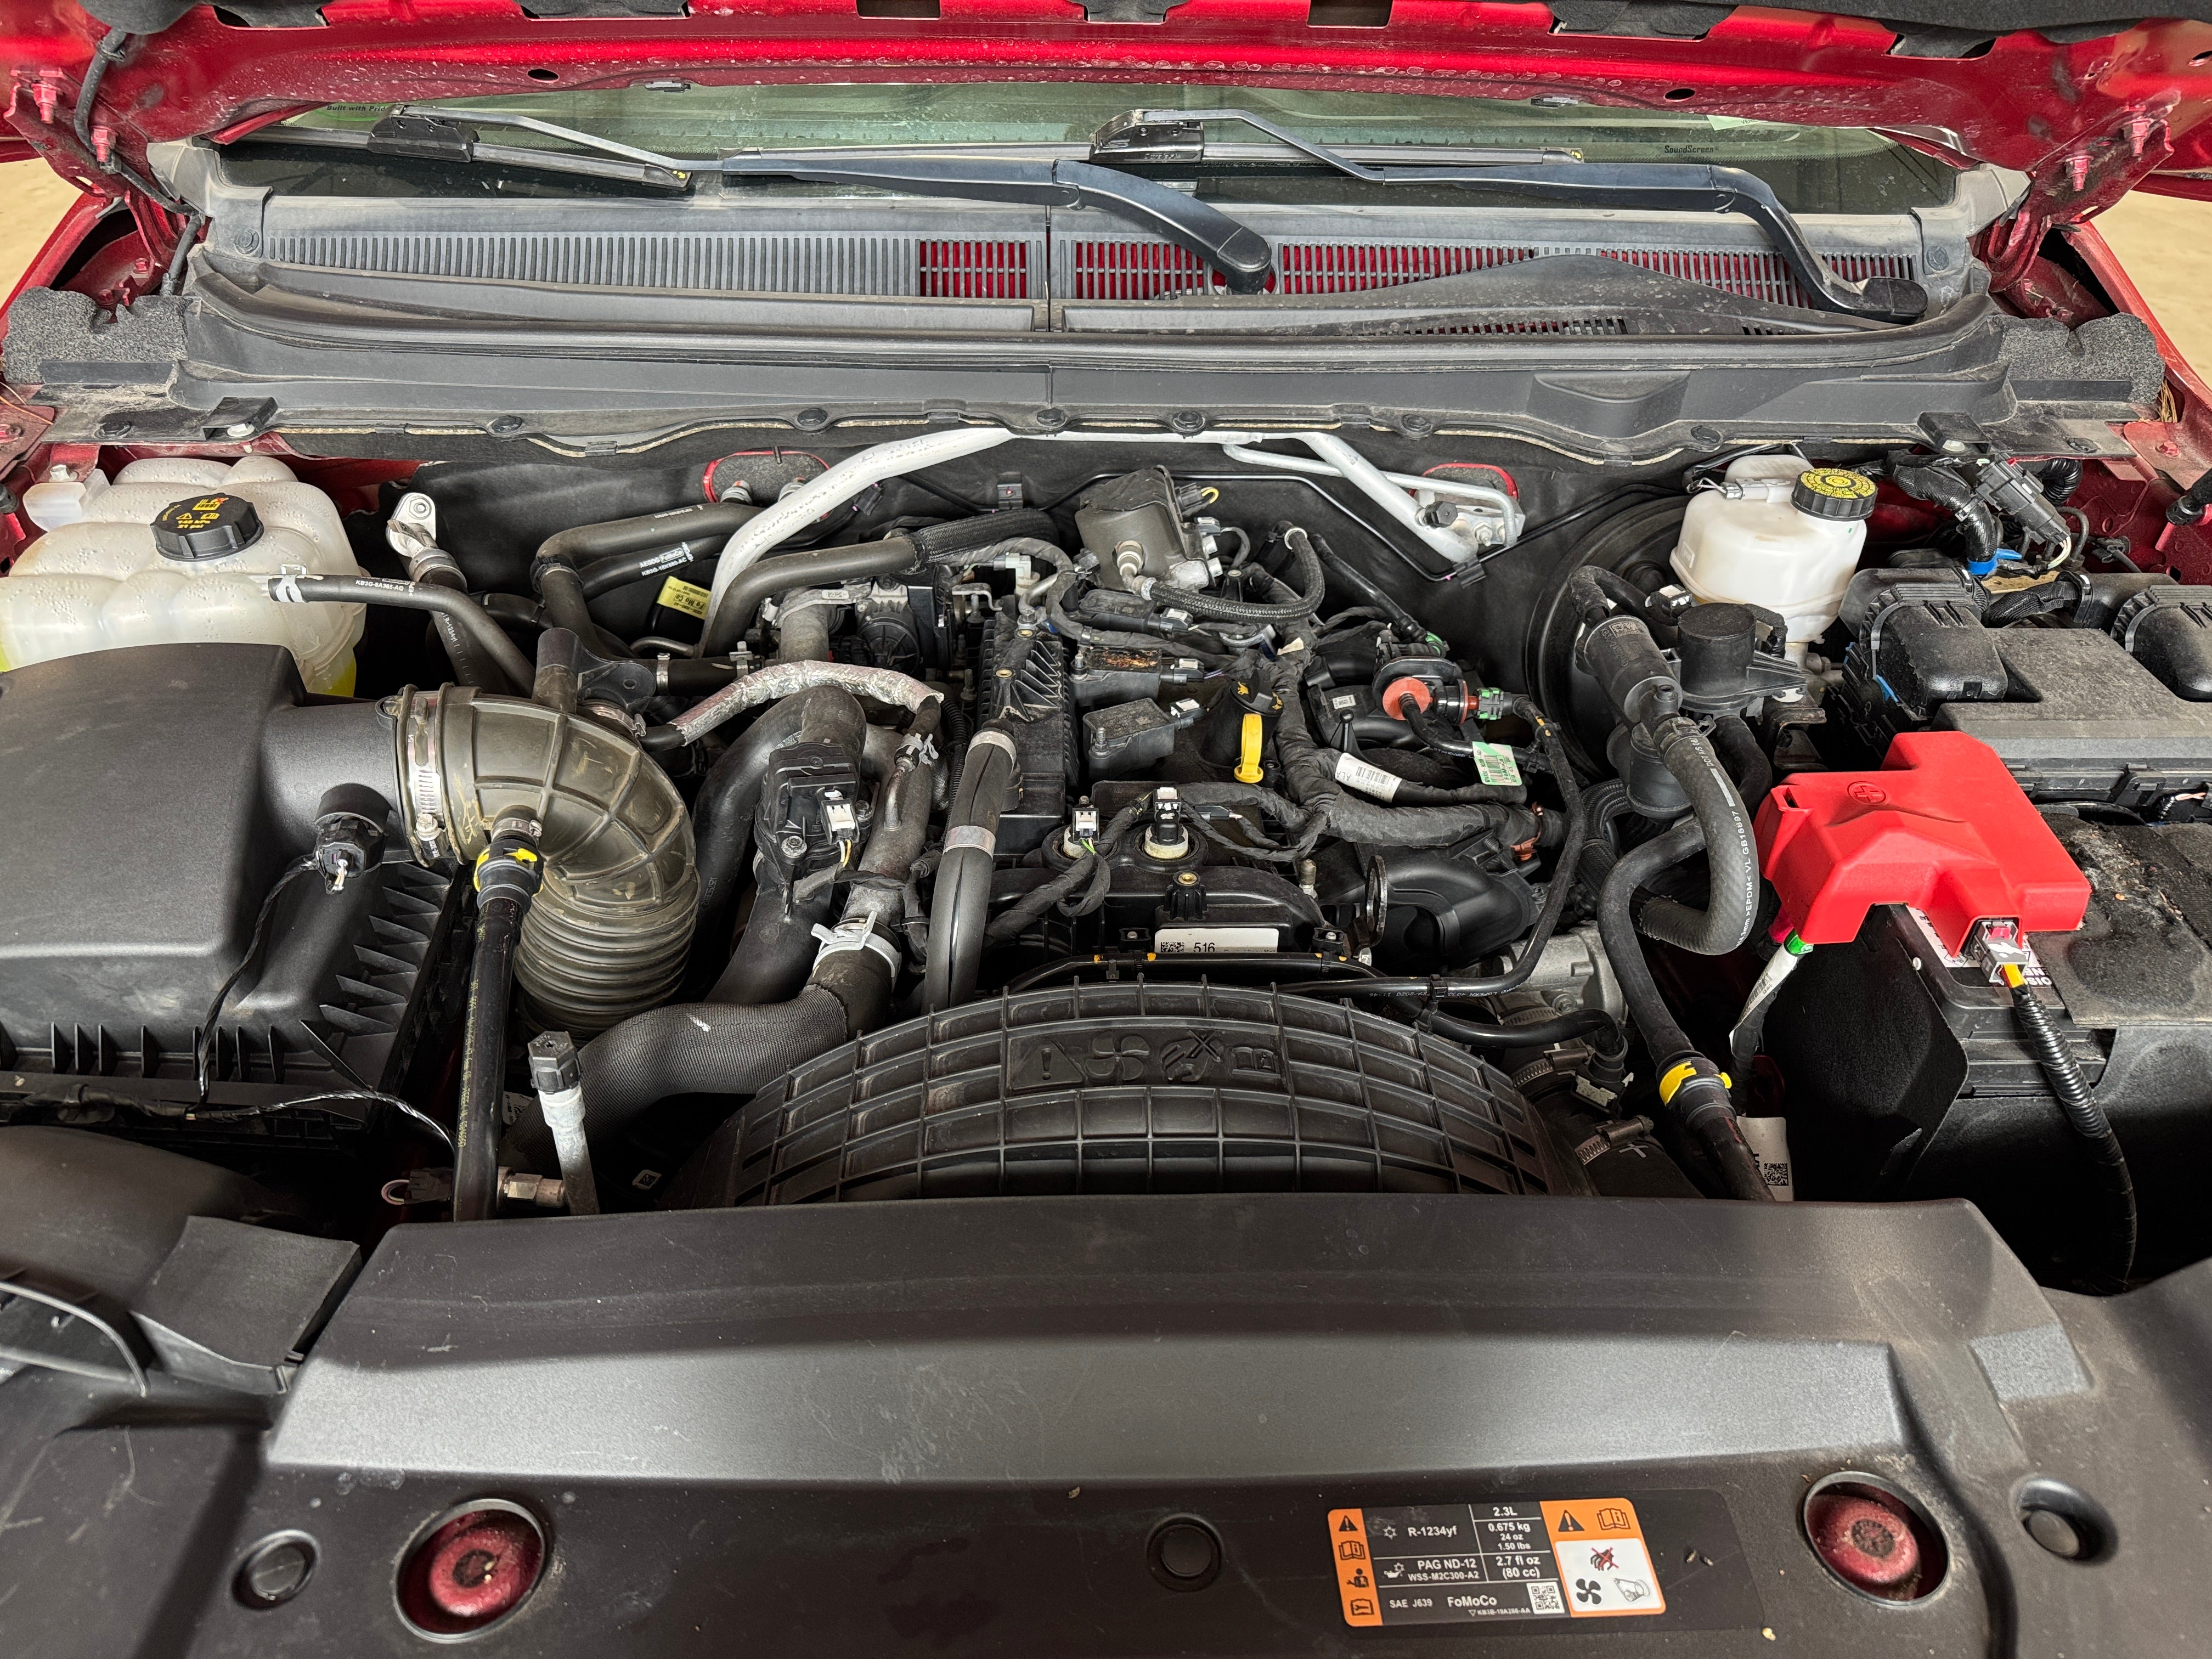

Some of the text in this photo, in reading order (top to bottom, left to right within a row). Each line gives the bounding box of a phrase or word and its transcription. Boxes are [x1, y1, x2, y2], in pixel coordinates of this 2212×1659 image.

[1664, 145, 1714, 154] SoundScreen
[1695, 746, 1706, 755] AIS
[1701, 755, 1714, 767] DOT
[1731, 810, 1750, 855] GB16897
[1744, 857, 1751, 873] VL
[1193, 942, 1216, 952] 516
[2023, 977, 2052, 986] OIS
[1492, 1506, 1518, 1517] 2.3L
[1408, 1525, 1458, 1538] R-1234yf
[1487, 1522, 1531, 1533] 0.675 kg
[1500, 1533, 1512, 1541] 24
[1497, 1542, 1532, 1551] 1.50 lbs
[1417, 1558, 1478, 1571] PAG ND-12
[1495, 1555, 1541, 1566] 2.7 fl oz
[1408, 1571, 1480, 1582] WSS-M2C300-A2
[1502, 1566, 1541, 1580] (80 cc)
[1389, 1598, 1433, 1609] SAE J639
[1447, 1595, 1498, 1607] FoMoCo
